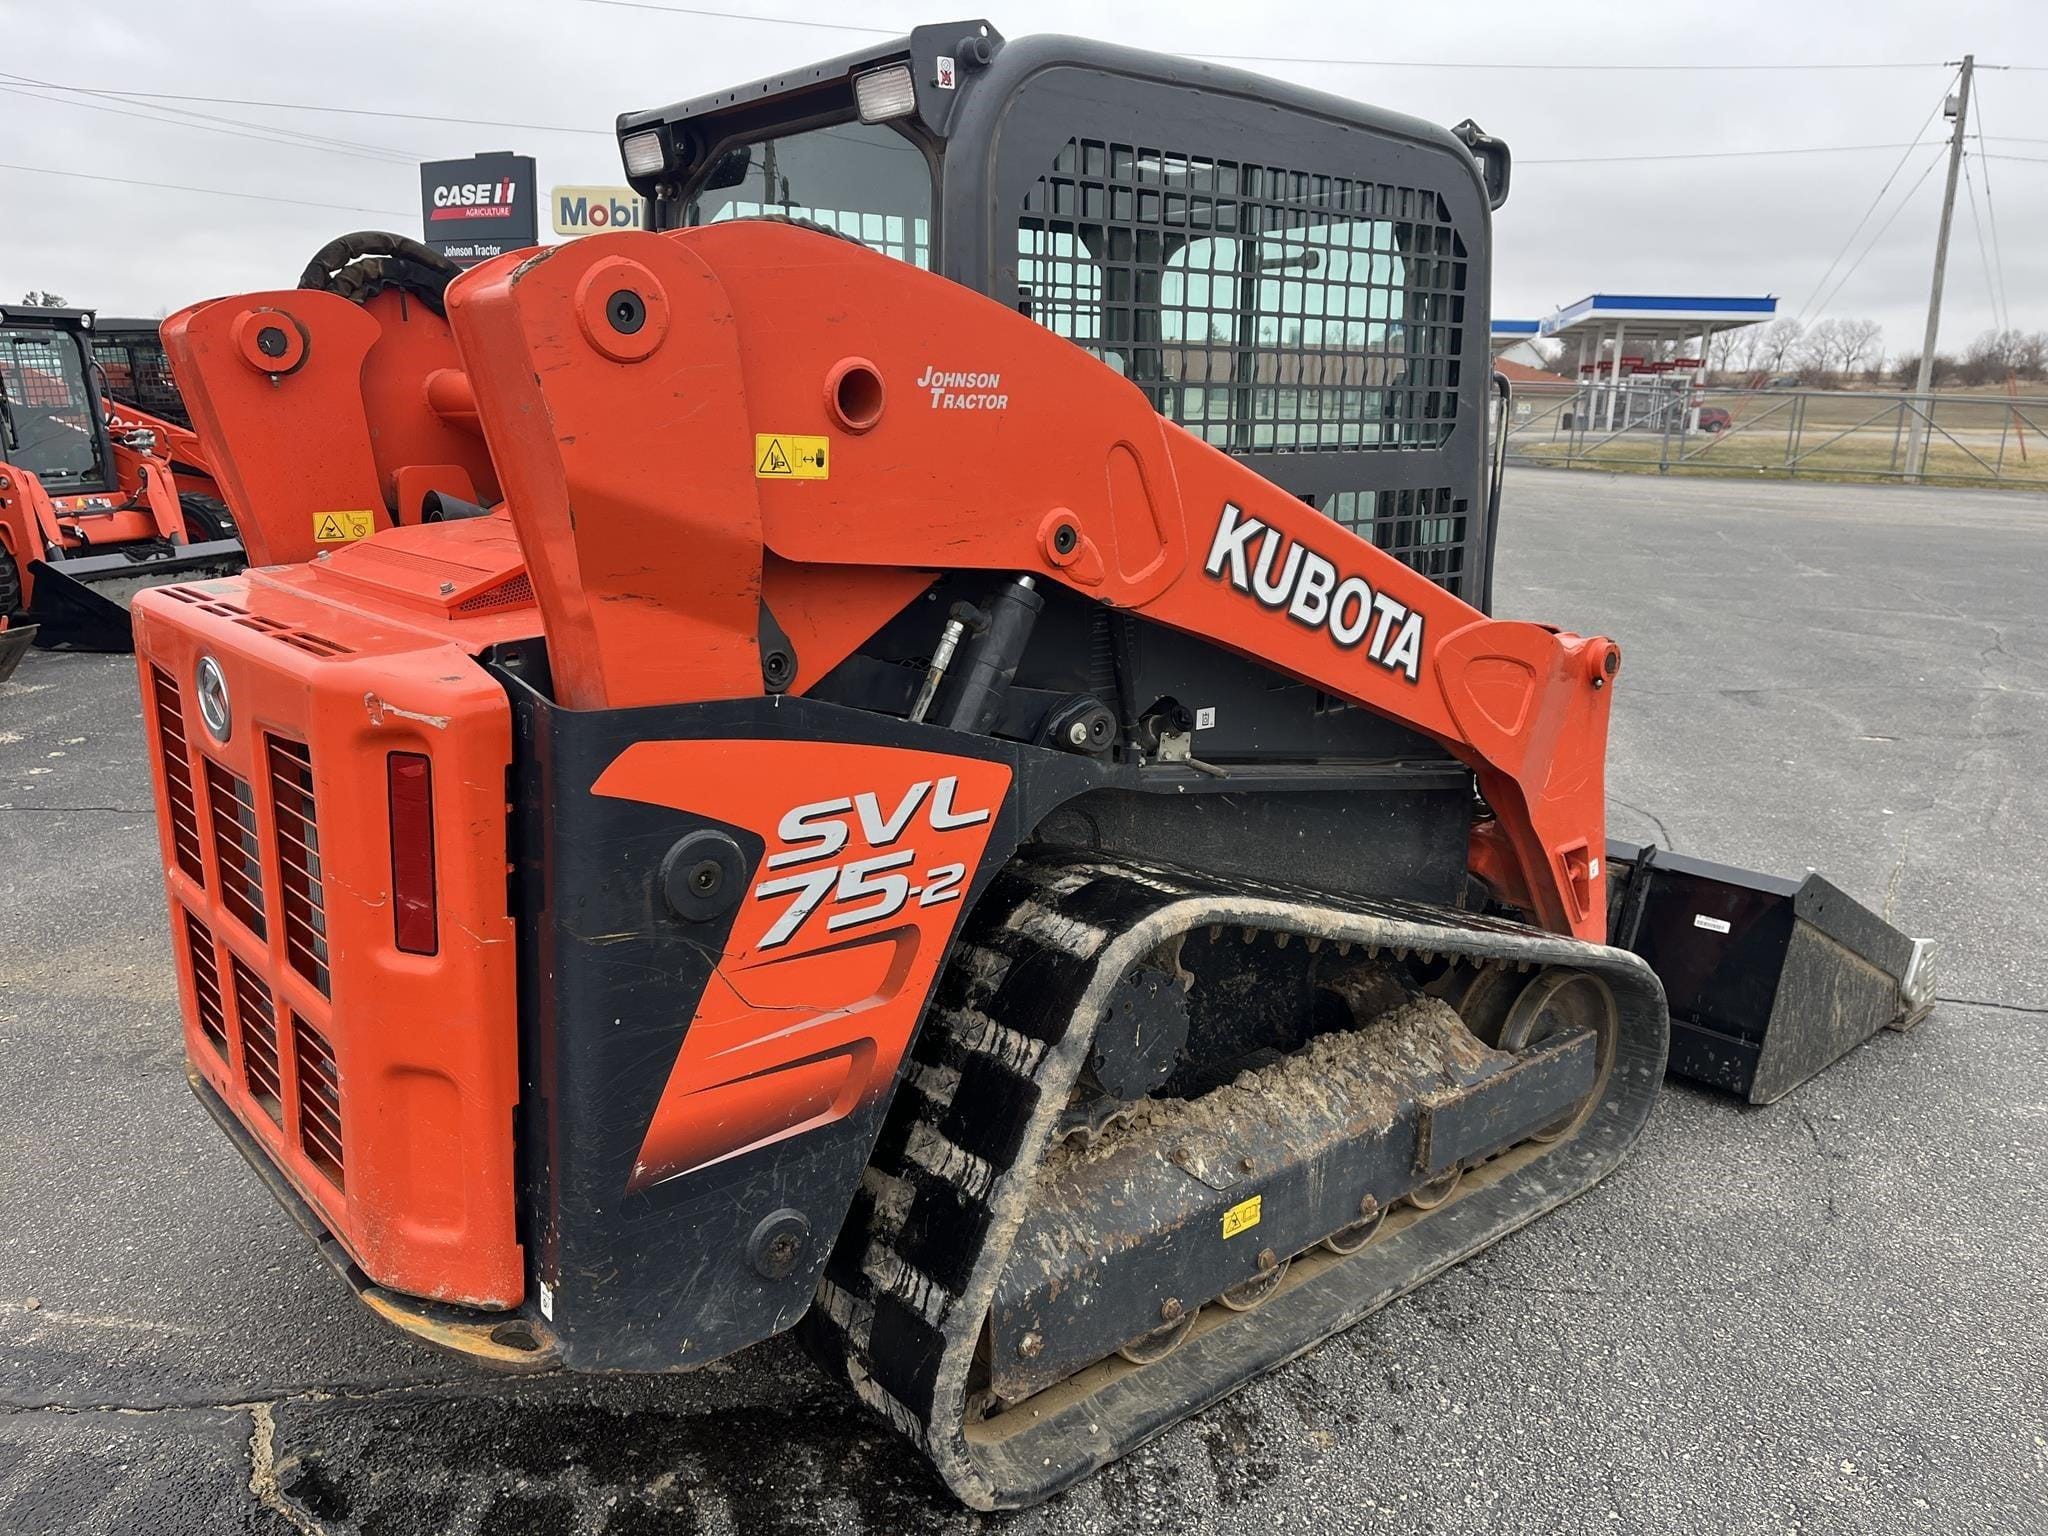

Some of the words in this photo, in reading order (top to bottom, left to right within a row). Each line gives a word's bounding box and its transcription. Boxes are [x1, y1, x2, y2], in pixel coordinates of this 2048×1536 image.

[433, 183, 492, 207] CASE
[465, 207, 511, 217] AGRICULTURE
[559, 196, 644, 227] Mobi
[443, 245, 473, 257] Johnson
[473, 244, 501, 256] Tractor
[917, 365, 1000, 388] JOHNSON
[930, 387, 1009, 409] TRACTOR
[1205, 502, 1424, 682] KUBOTA
[767, 776, 990, 870] SVL
[754, 848, 966, 951] 75-2
